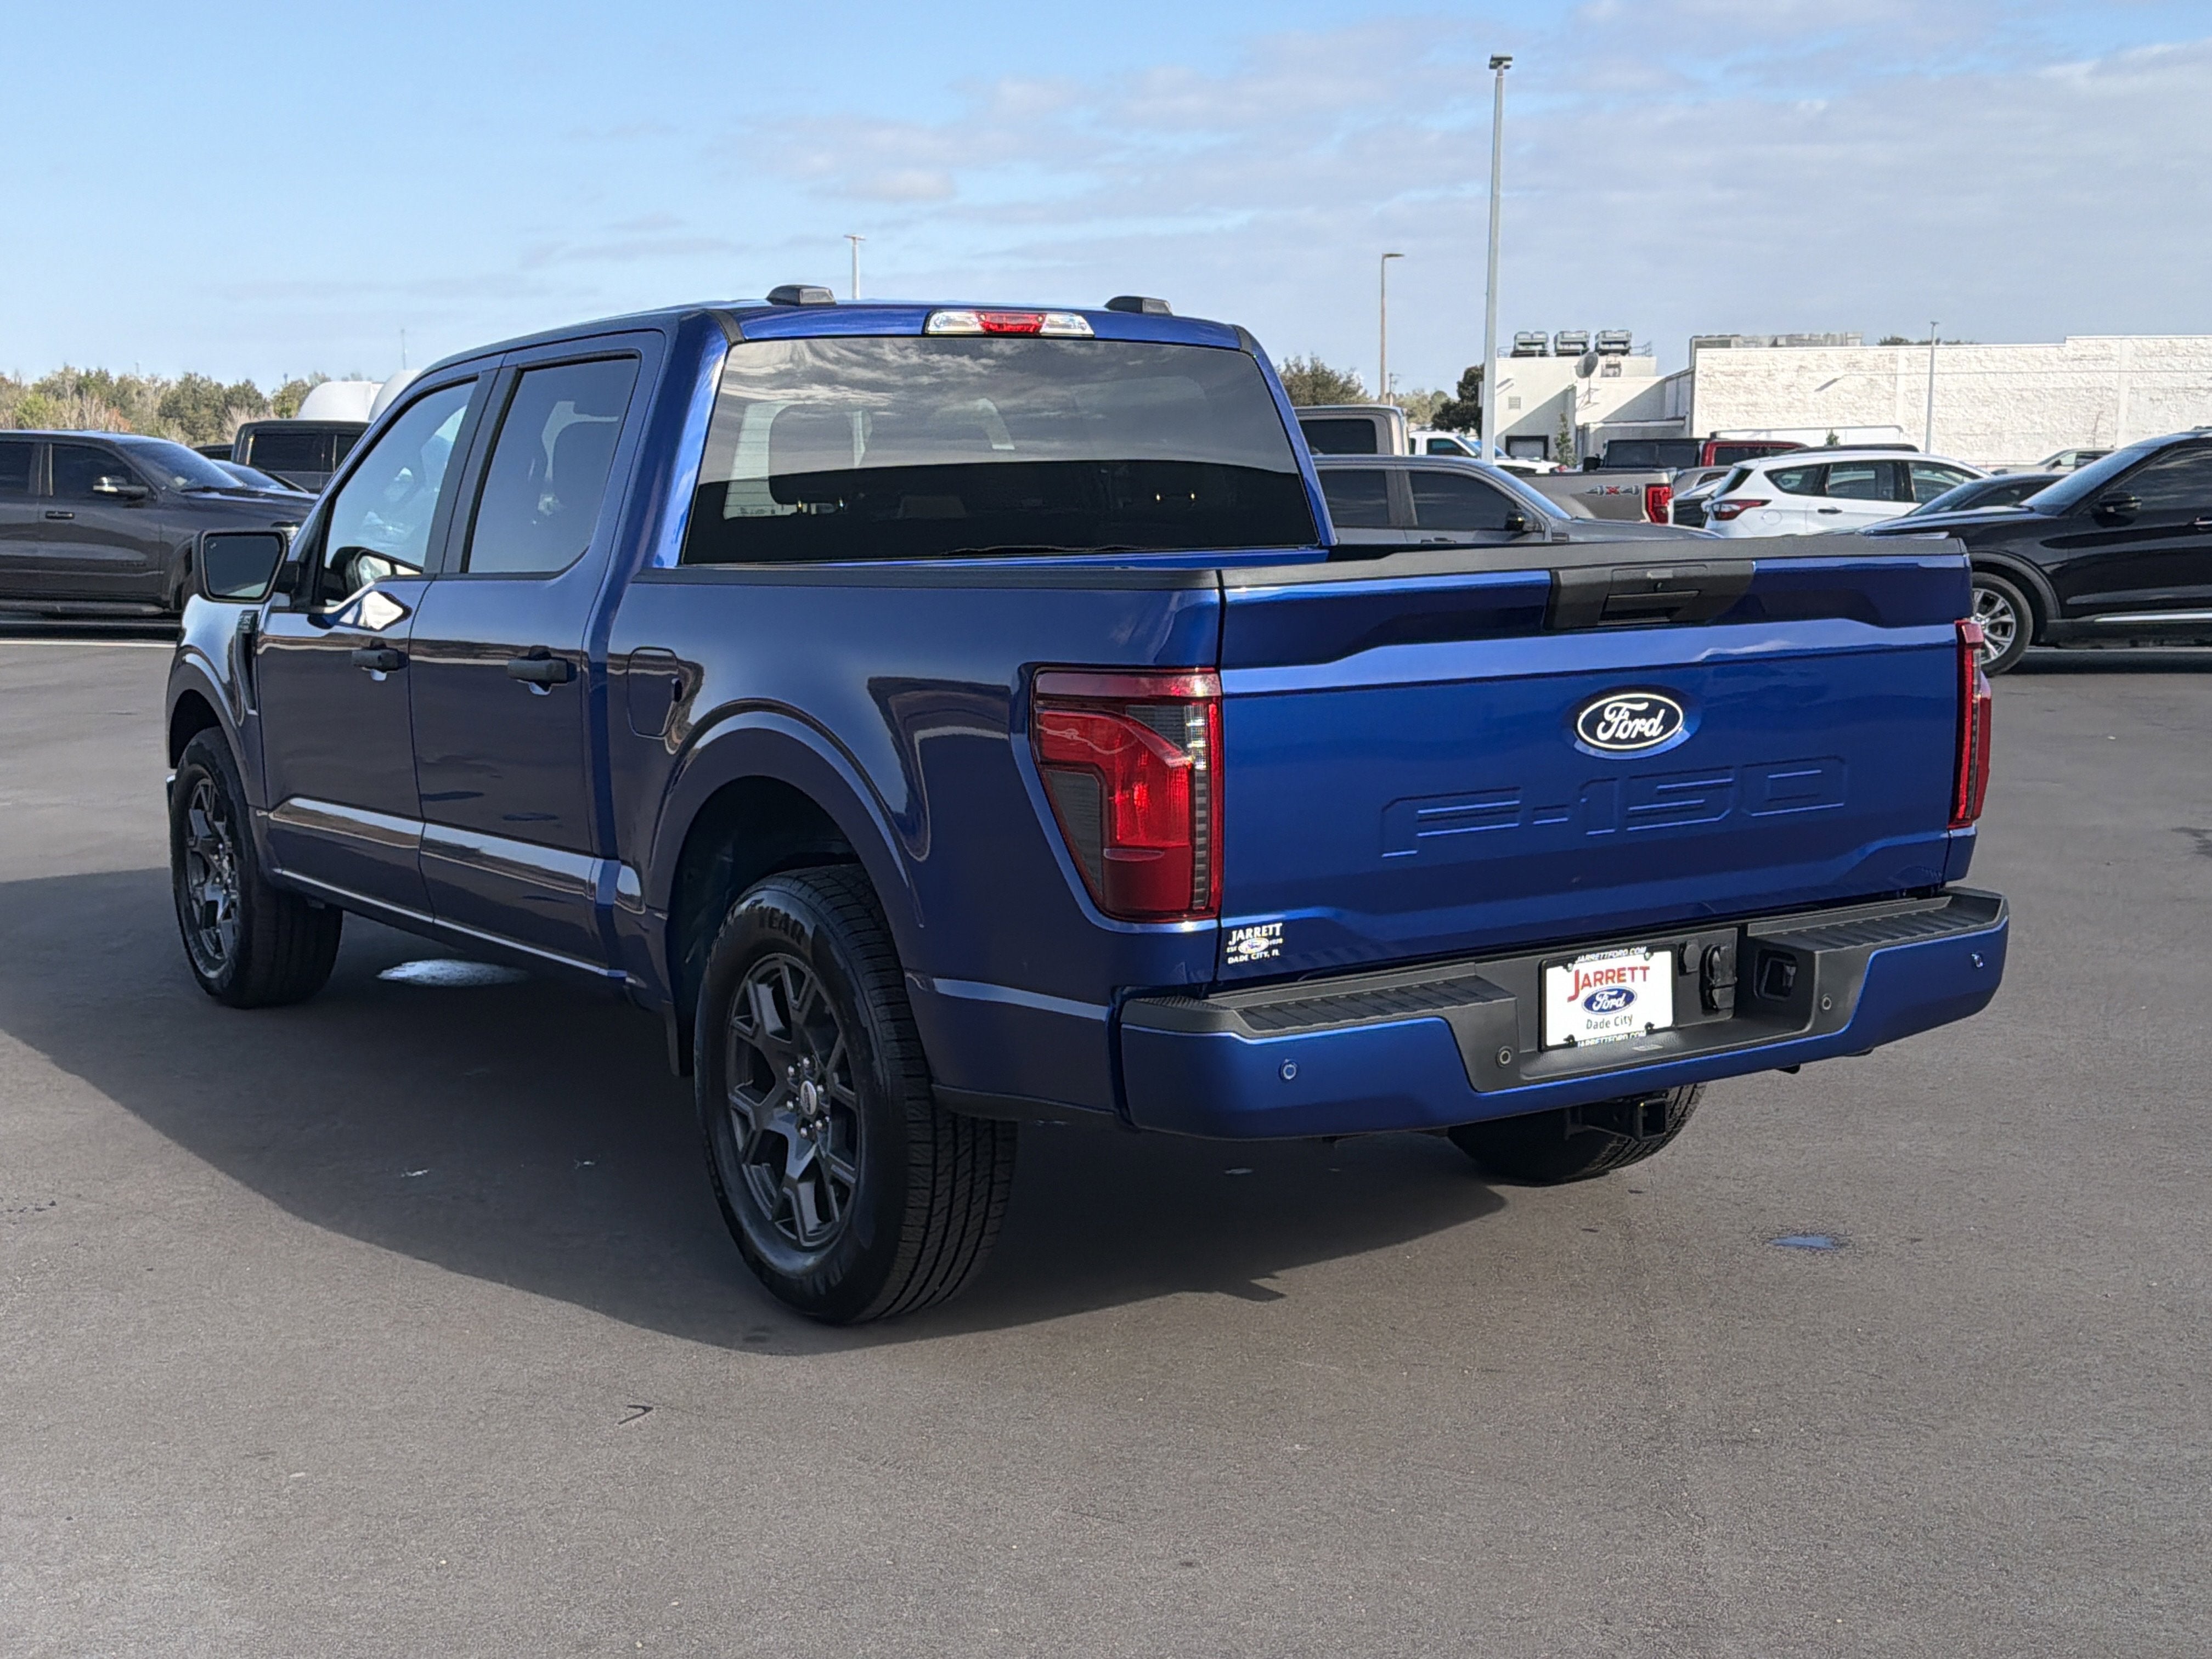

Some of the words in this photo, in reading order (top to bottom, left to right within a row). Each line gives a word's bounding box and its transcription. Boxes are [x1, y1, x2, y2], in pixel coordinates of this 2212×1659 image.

[1597, 702, 1665, 740] Ford
[1382, 755, 1846, 857] F-150
[1228, 923, 1283, 945] JARRETT
[1567, 966, 1650, 1002] JARRETT
[1592, 990, 1626, 1011] Ford
[1586, 1018, 1610, 1030] Dade
[1614, 1014, 1633, 1027] City
